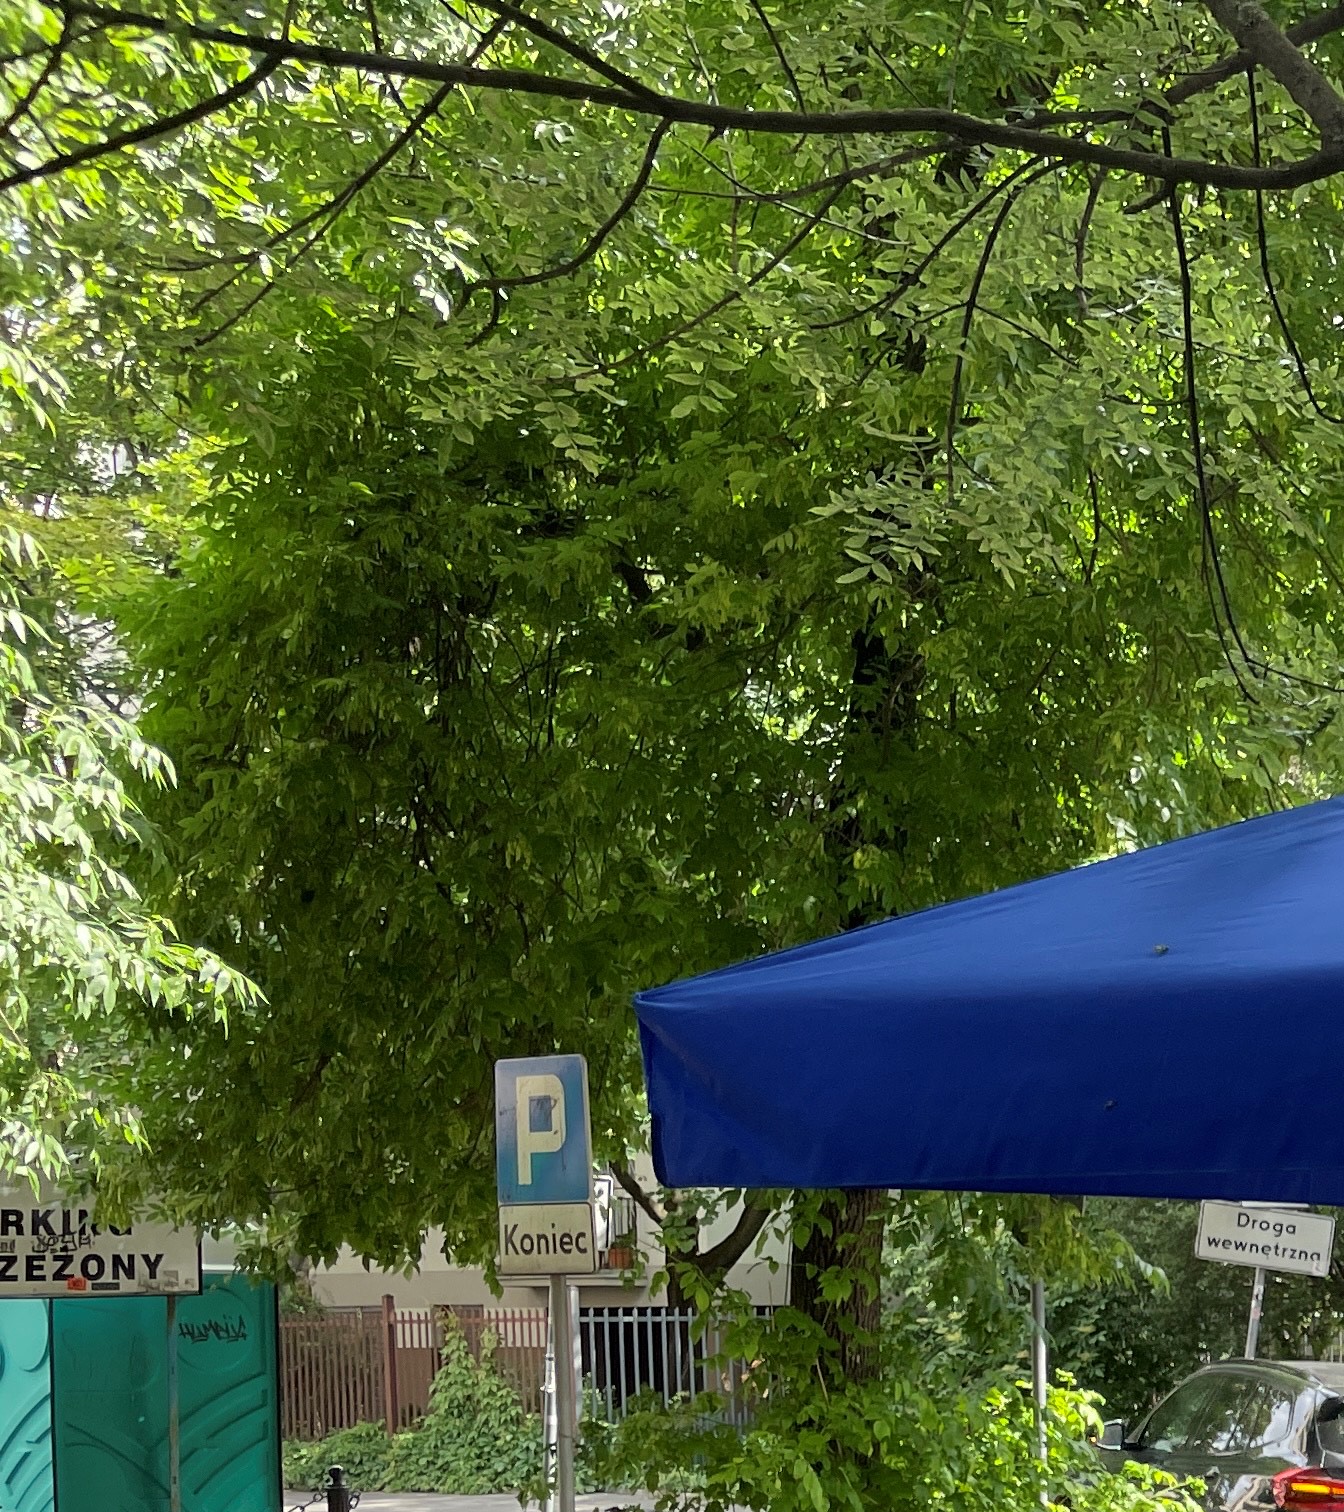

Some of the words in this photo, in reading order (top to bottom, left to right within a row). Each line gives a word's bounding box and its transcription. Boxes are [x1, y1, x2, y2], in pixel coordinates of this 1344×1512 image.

[516, 1074, 566, 1185] P
[504, 1222, 588, 1256] Koniec
[1237, 1212, 1297, 1238] Droga
[1207, 1236, 1321, 1262] wewnętrzna
